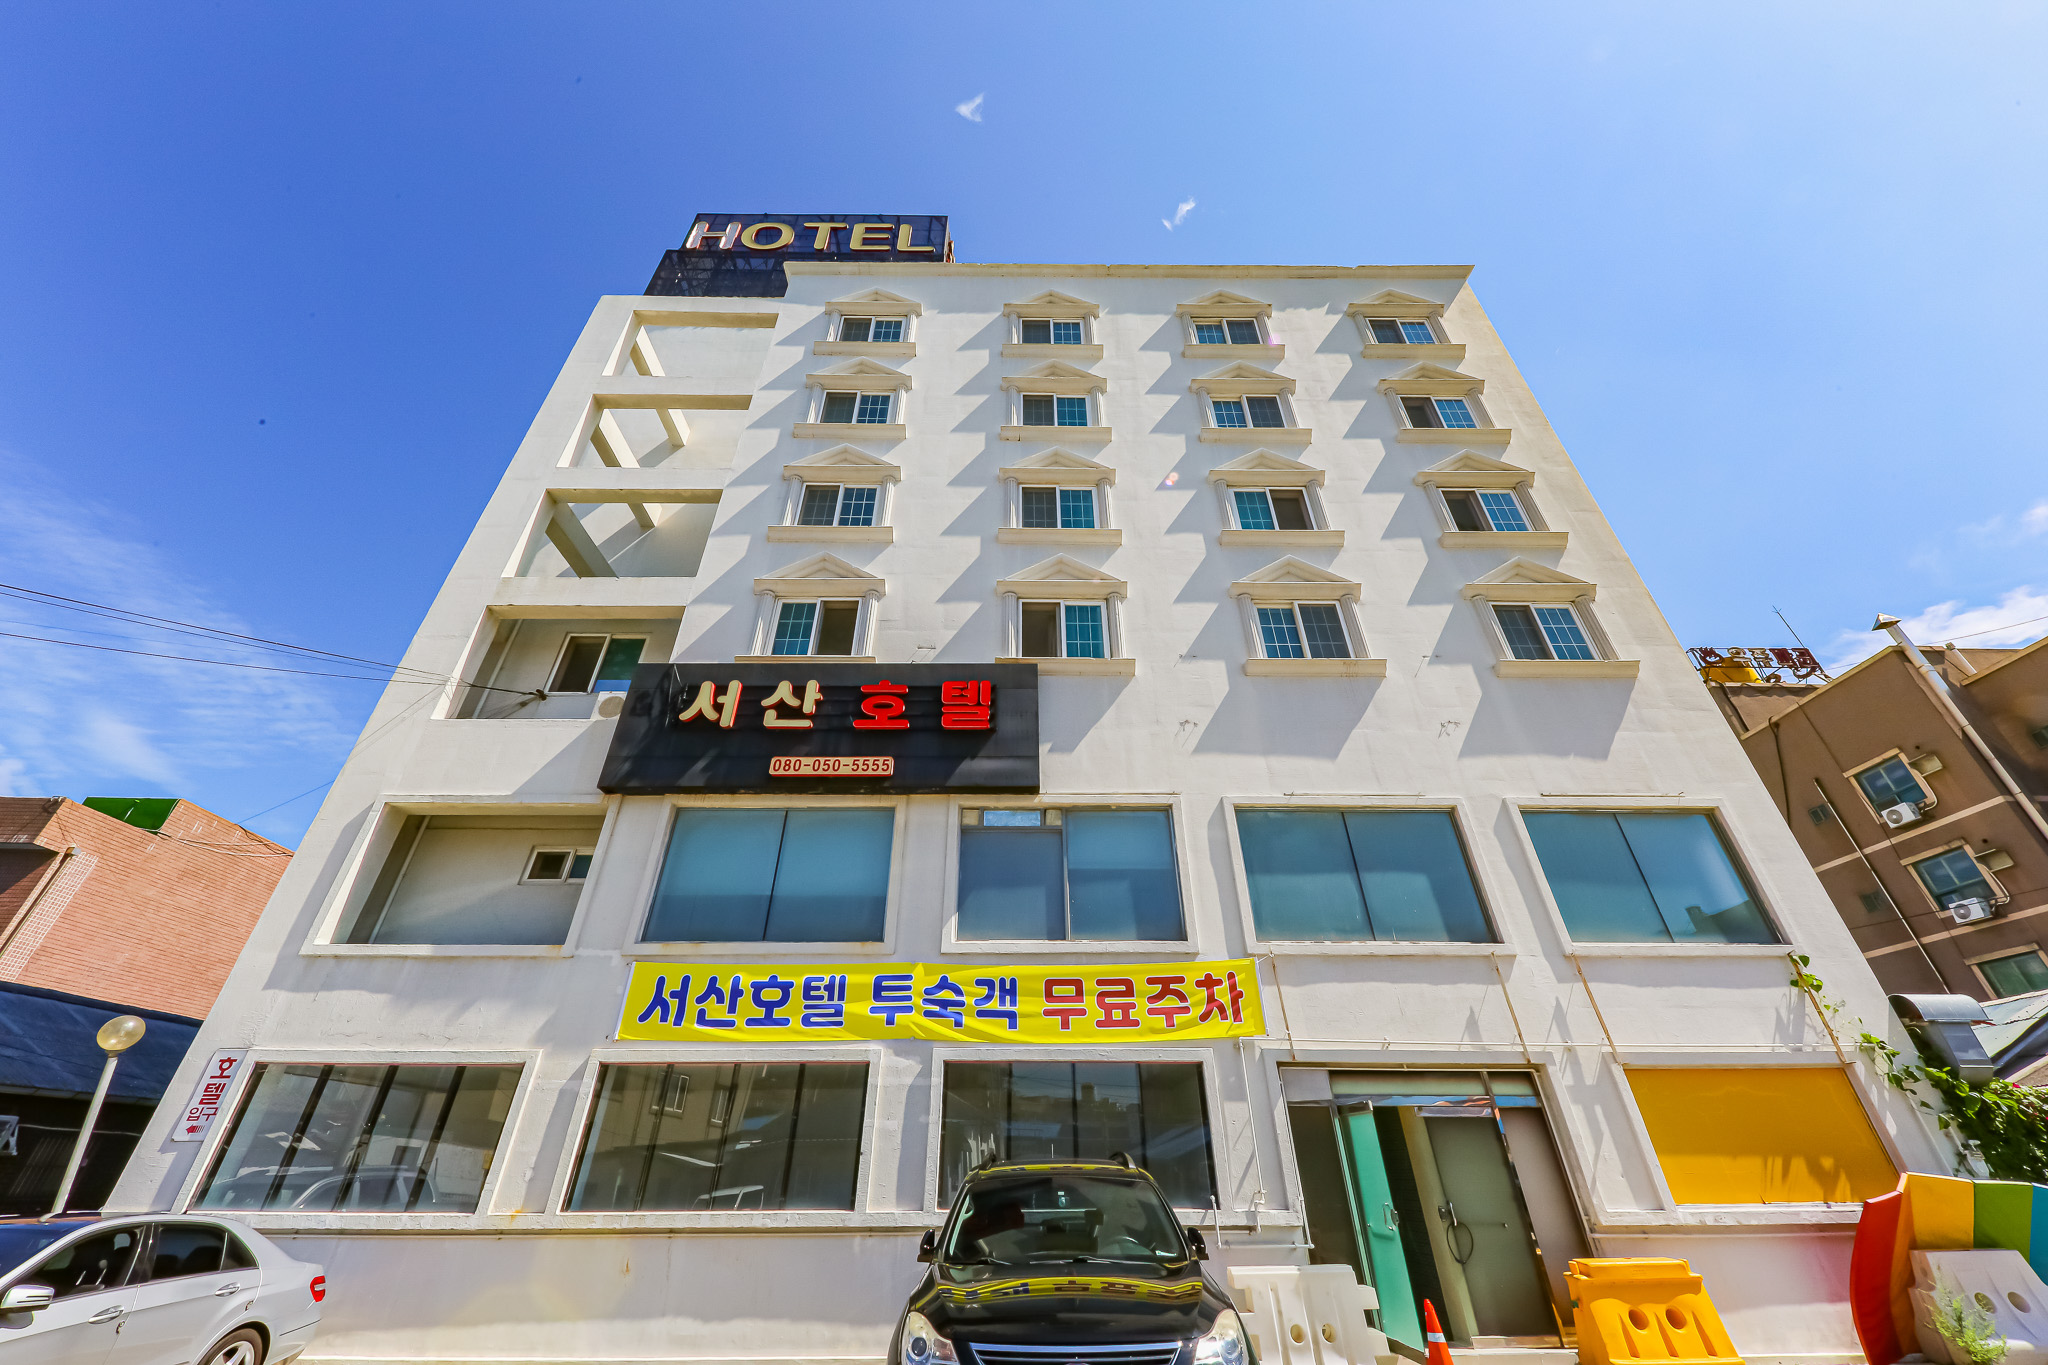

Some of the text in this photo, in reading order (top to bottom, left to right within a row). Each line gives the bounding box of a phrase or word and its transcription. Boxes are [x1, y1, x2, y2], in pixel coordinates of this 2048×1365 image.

[685, 221, 936, 252] HOTEL
[772, 758, 891, 773] 080-050-5555
[637, 971, 1245, 1031] 서산호텔 투숙객 무료주차
[199, 1057, 238, 1105] 호텔
[186, 1107, 219, 1121] 입구
